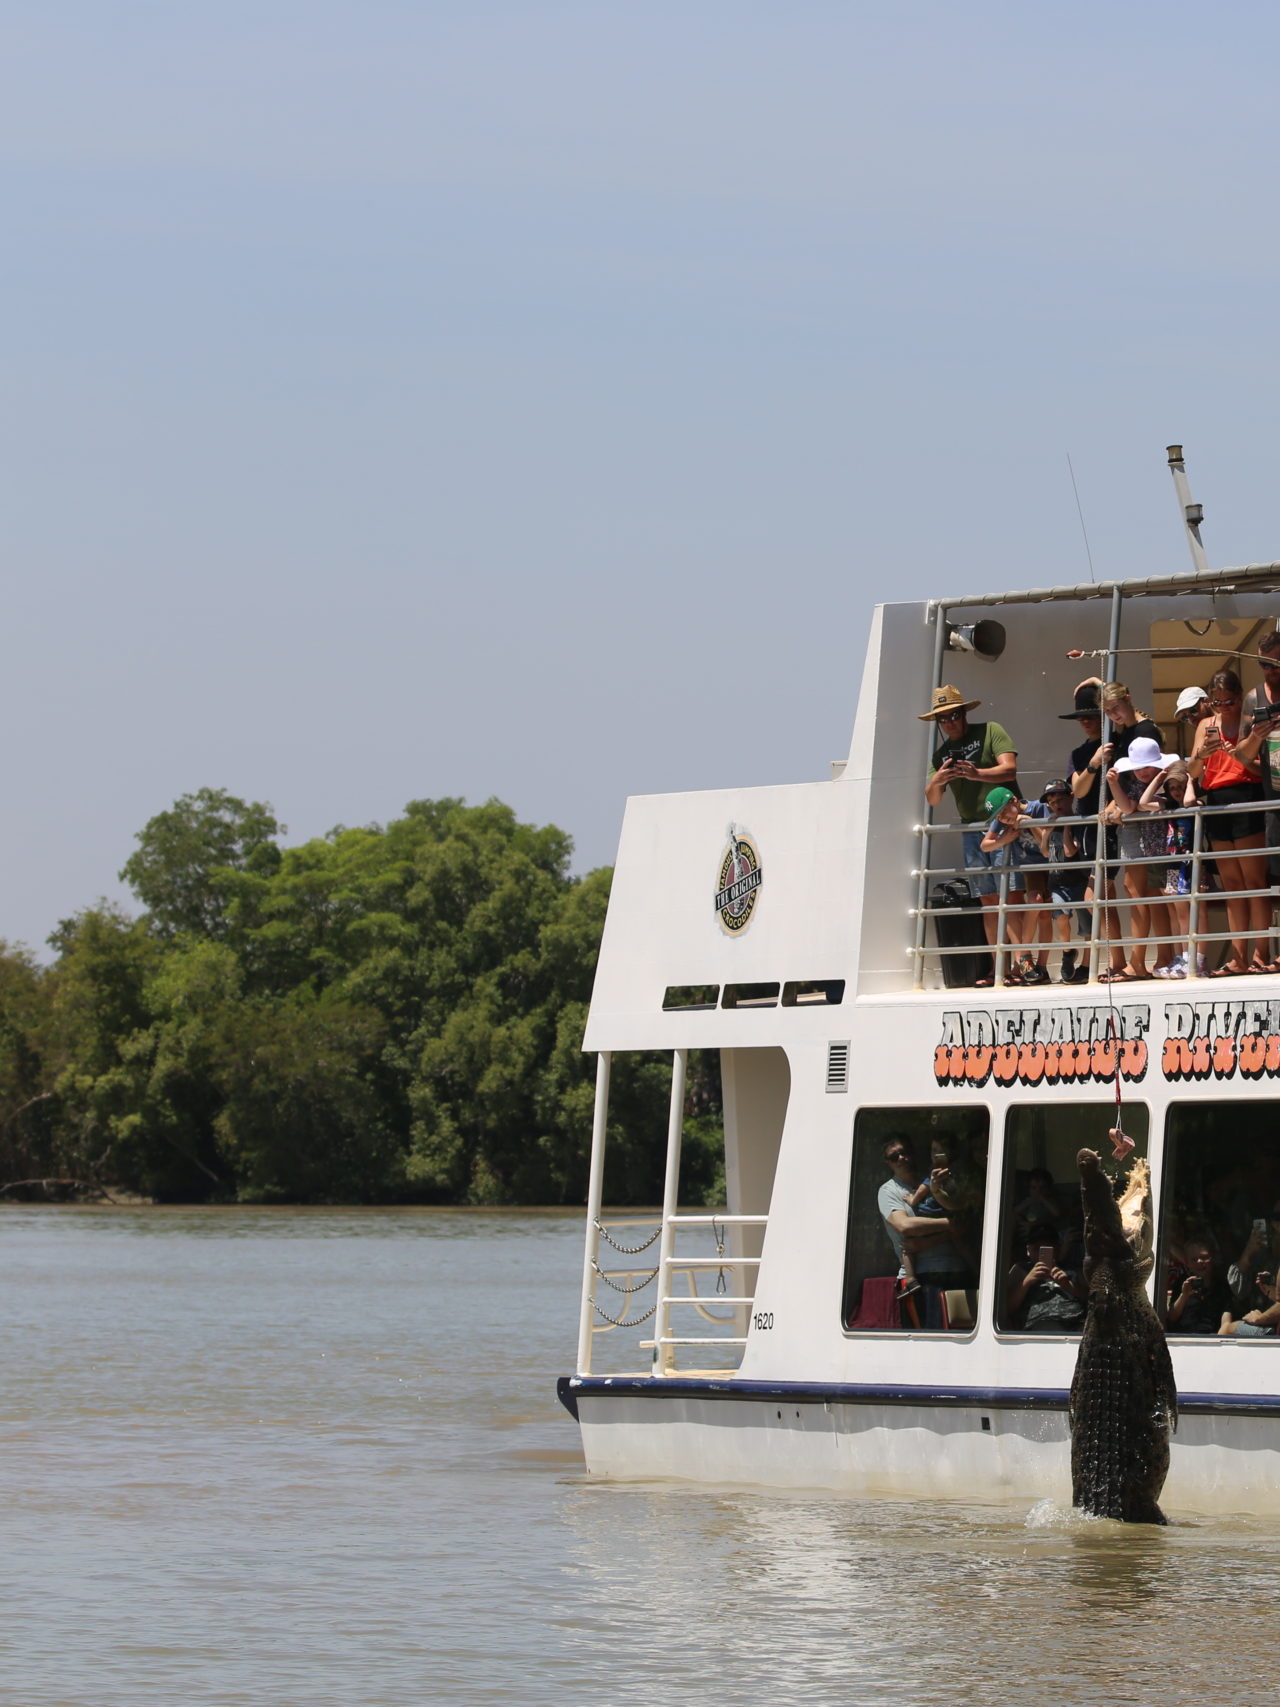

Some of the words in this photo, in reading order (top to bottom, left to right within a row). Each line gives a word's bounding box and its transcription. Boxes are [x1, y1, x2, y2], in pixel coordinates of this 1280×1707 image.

[720, 851, 734, 889] FAMOUS
[717, 891, 729, 909] THE
[730, 871, 760, 900] ORIGINAL
[934, 1004, 1151, 1088] ADELAIDE
[753, 1312, 774, 1330] 1620
